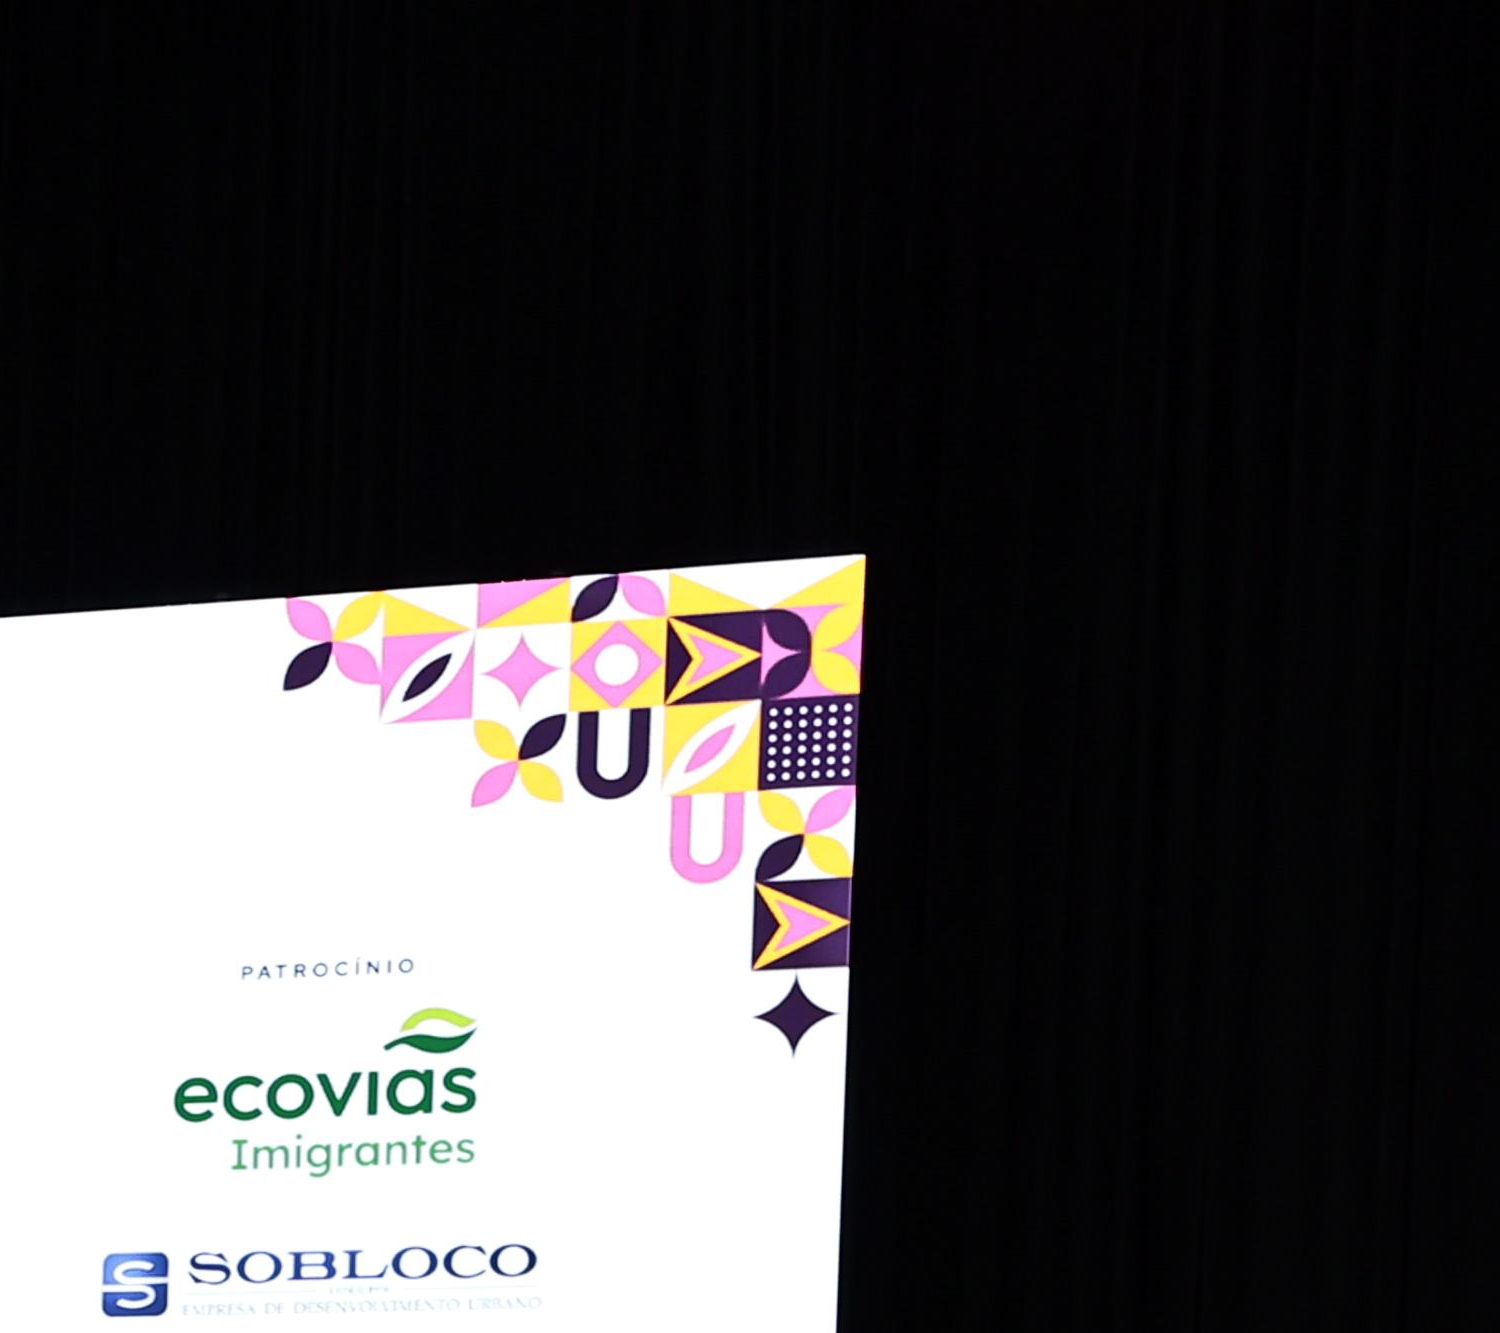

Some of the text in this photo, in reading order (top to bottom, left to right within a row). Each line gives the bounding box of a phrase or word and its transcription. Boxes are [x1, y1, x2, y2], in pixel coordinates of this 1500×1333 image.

[240, 957, 415, 980] PATROCÍNIO
[173, 1066, 478, 1124] ecovias
[230, 1133, 476, 1178] Imigrantes
[188, 1243, 539, 1286] SOBLOCO
